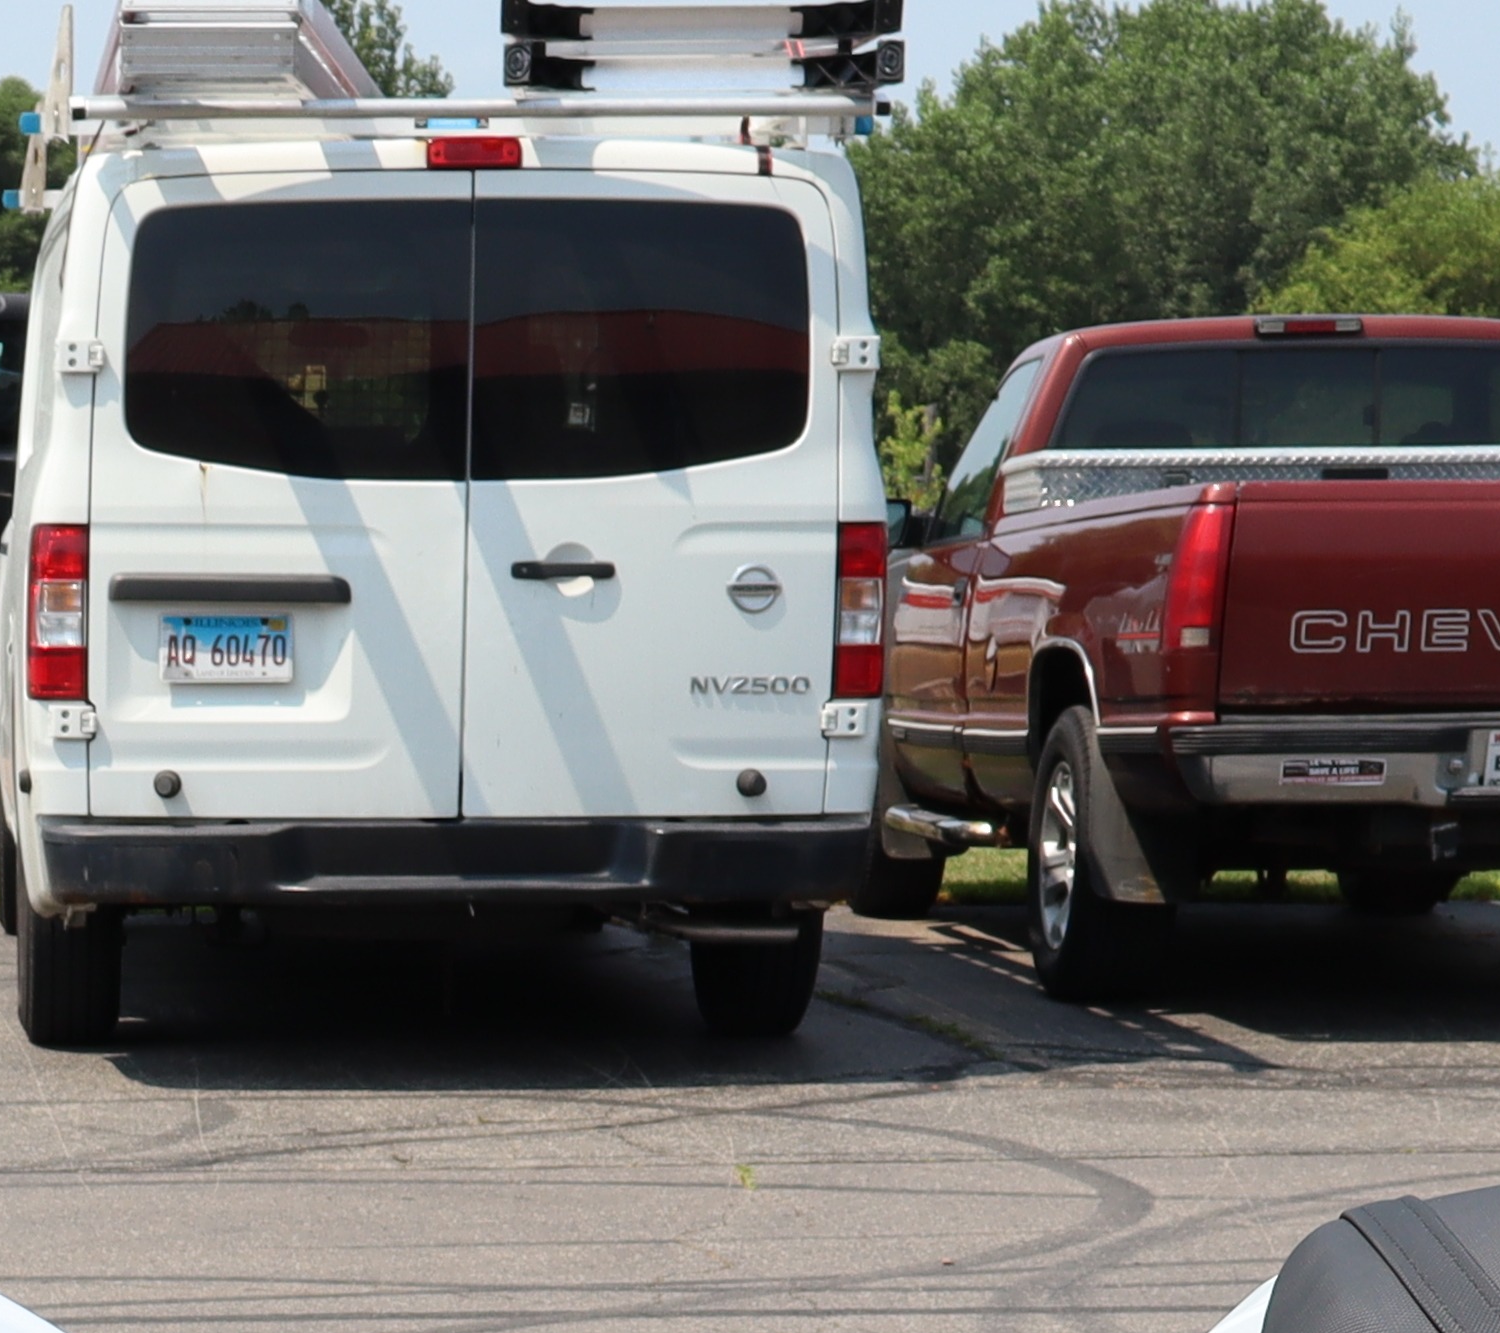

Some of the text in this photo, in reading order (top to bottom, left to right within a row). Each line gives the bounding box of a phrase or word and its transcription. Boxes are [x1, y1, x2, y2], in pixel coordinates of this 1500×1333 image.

[194, 616, 260, 628] ILLINOIS
[167, 634, 287, 667] AQ 60470
[689, 675, 812, 695] NV2500
